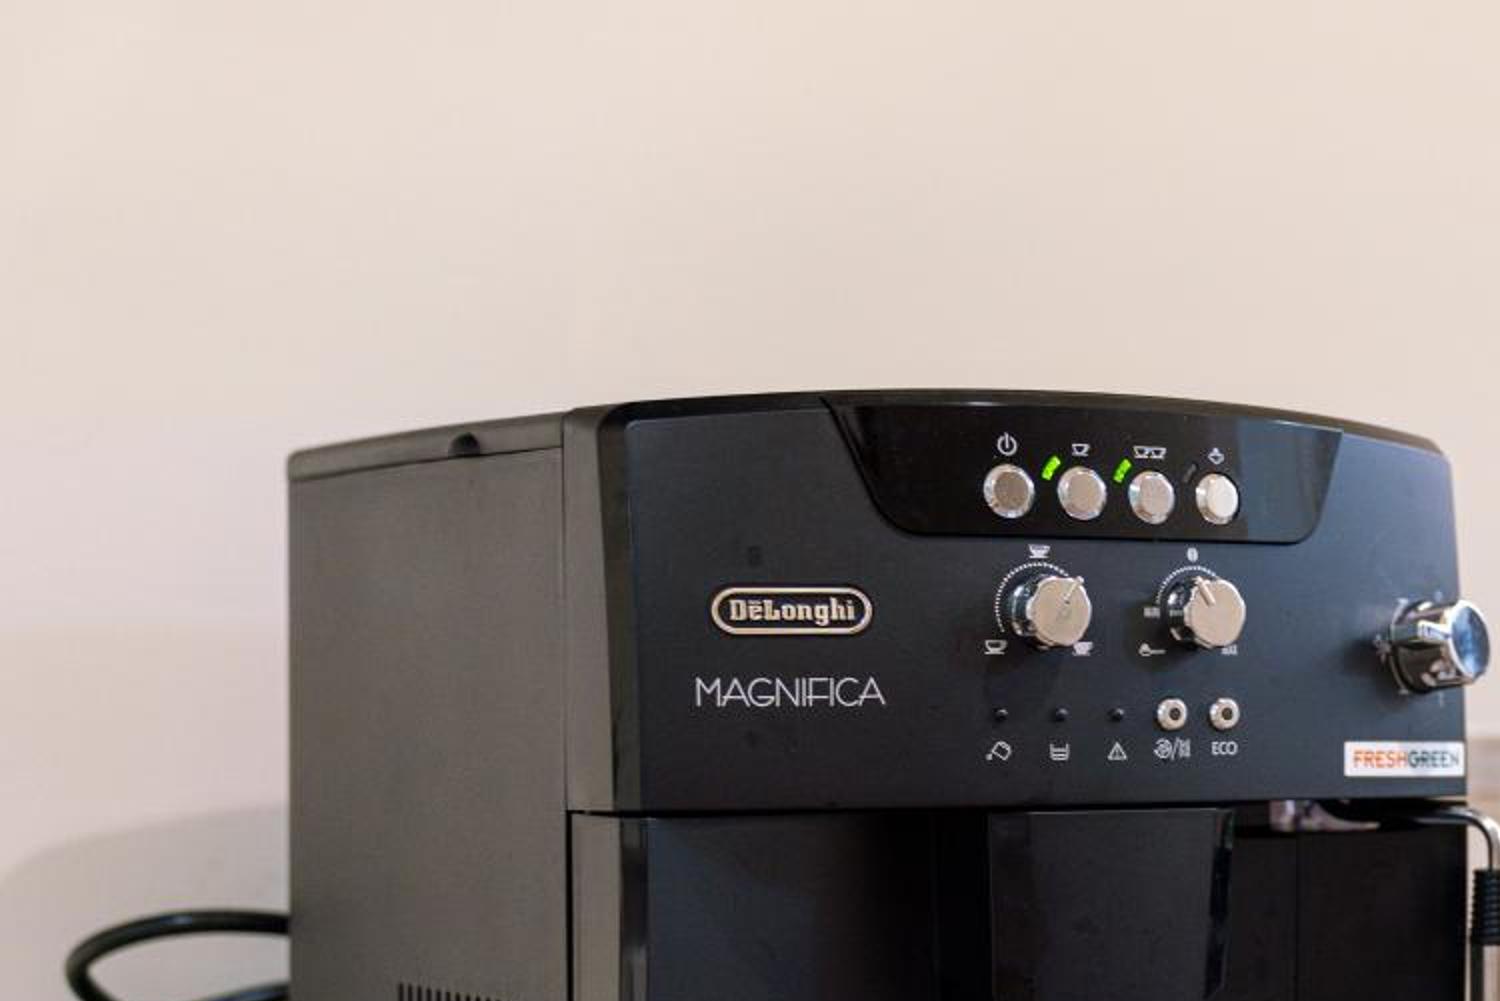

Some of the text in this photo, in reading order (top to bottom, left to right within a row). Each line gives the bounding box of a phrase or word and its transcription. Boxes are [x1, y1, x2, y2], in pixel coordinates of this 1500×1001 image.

[695, 676, 887, 707] MAGNIFICA
[1211, 741, 1238, 755] ECO
[1353, 750, 1459, 769] FRESHGREEN
